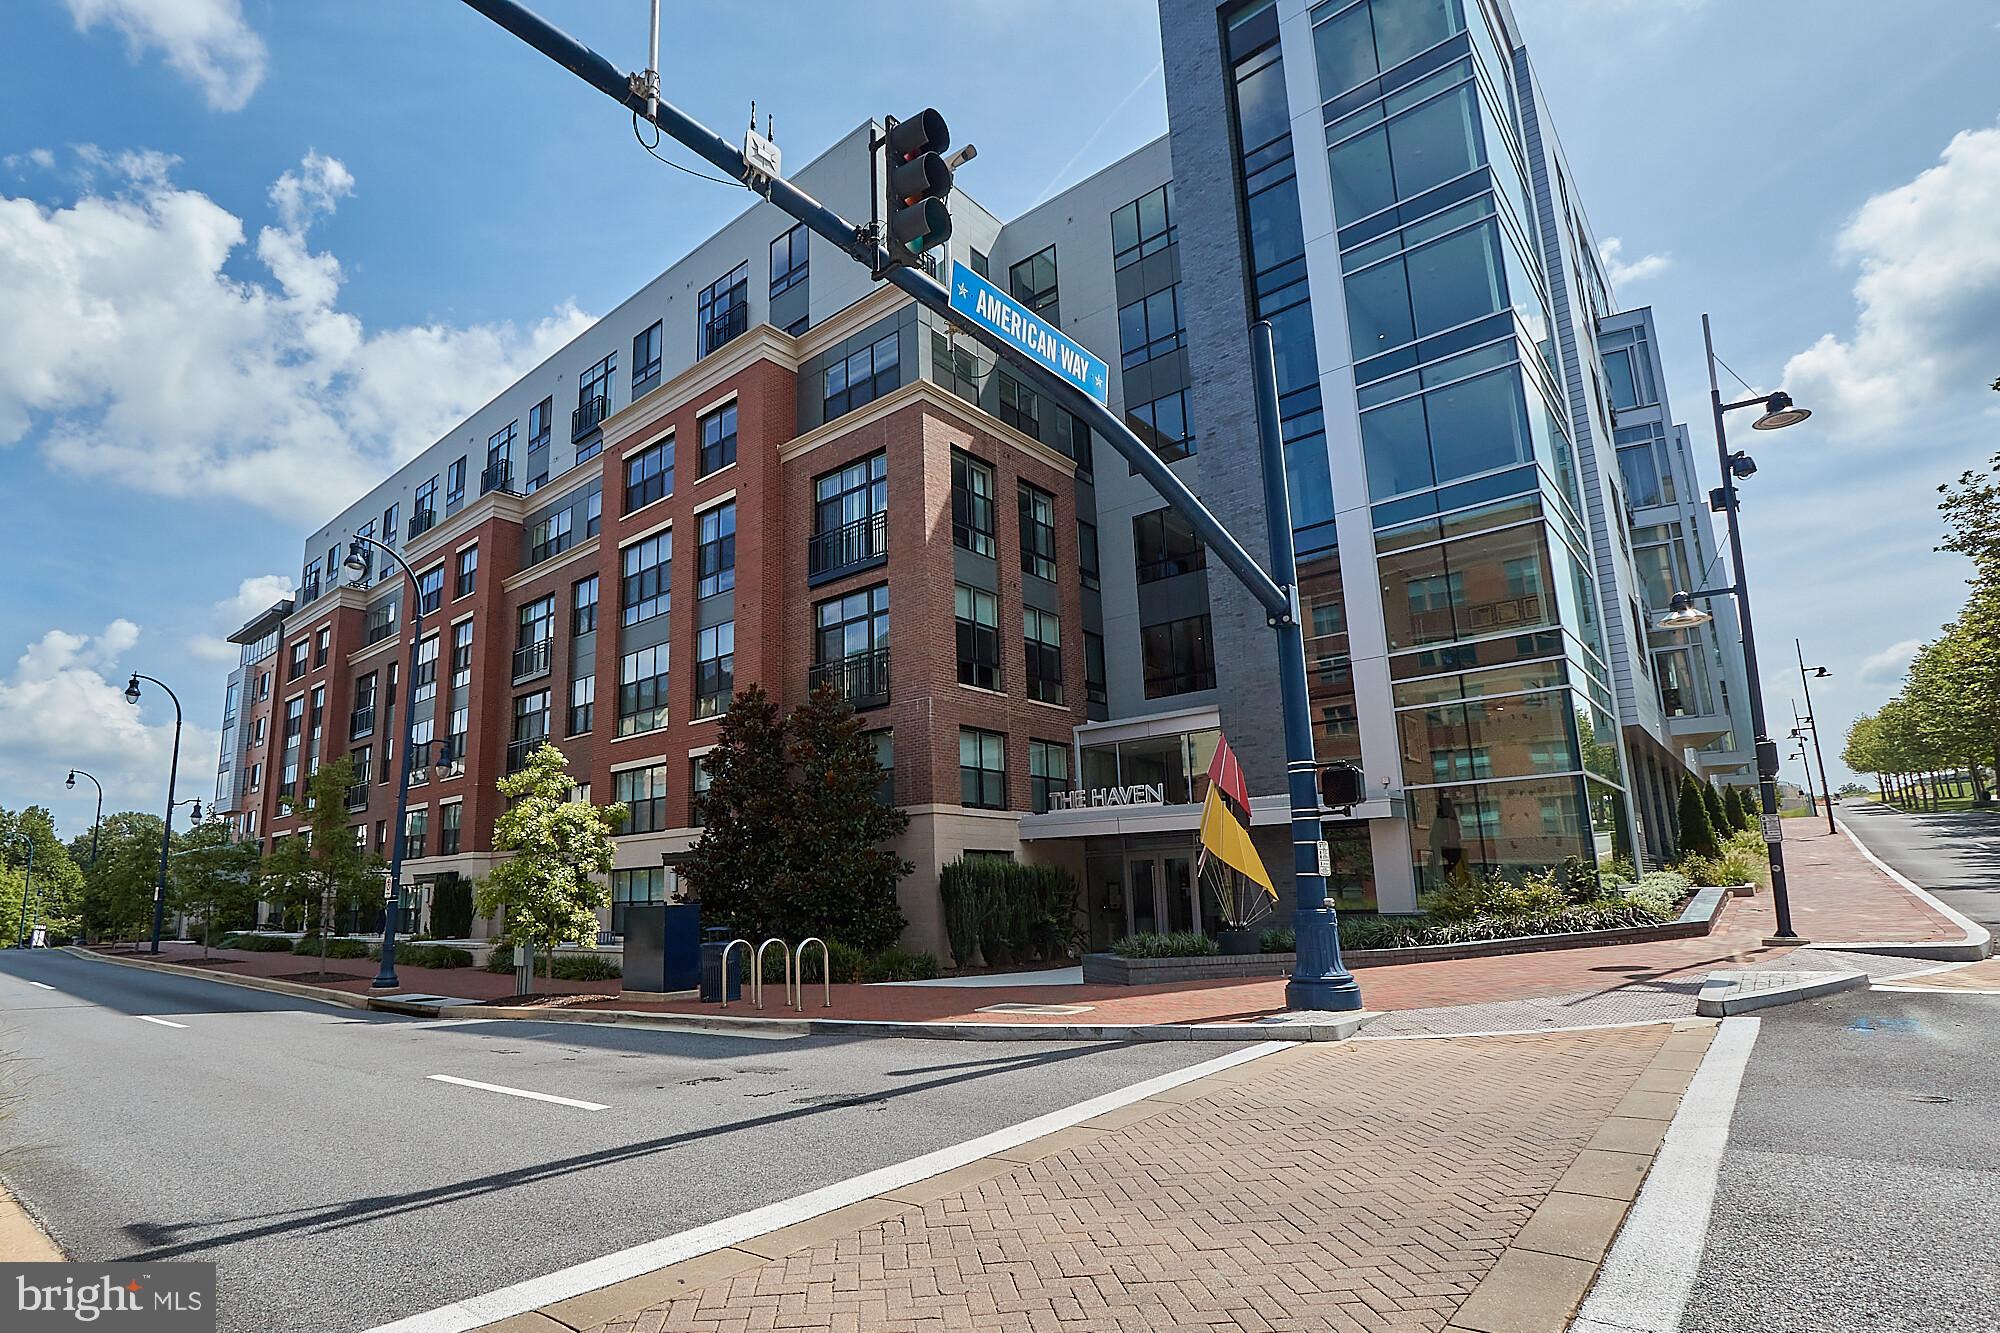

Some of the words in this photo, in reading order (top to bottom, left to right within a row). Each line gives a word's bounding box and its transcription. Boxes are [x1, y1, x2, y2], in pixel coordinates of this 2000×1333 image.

[976, 289, 1057, 363] AMERICAN
[1060, 344, 1089, 383] WAY
[1049, 790, 1086, 811] THE
[1091, 783, 1164, 808] HAVEN
